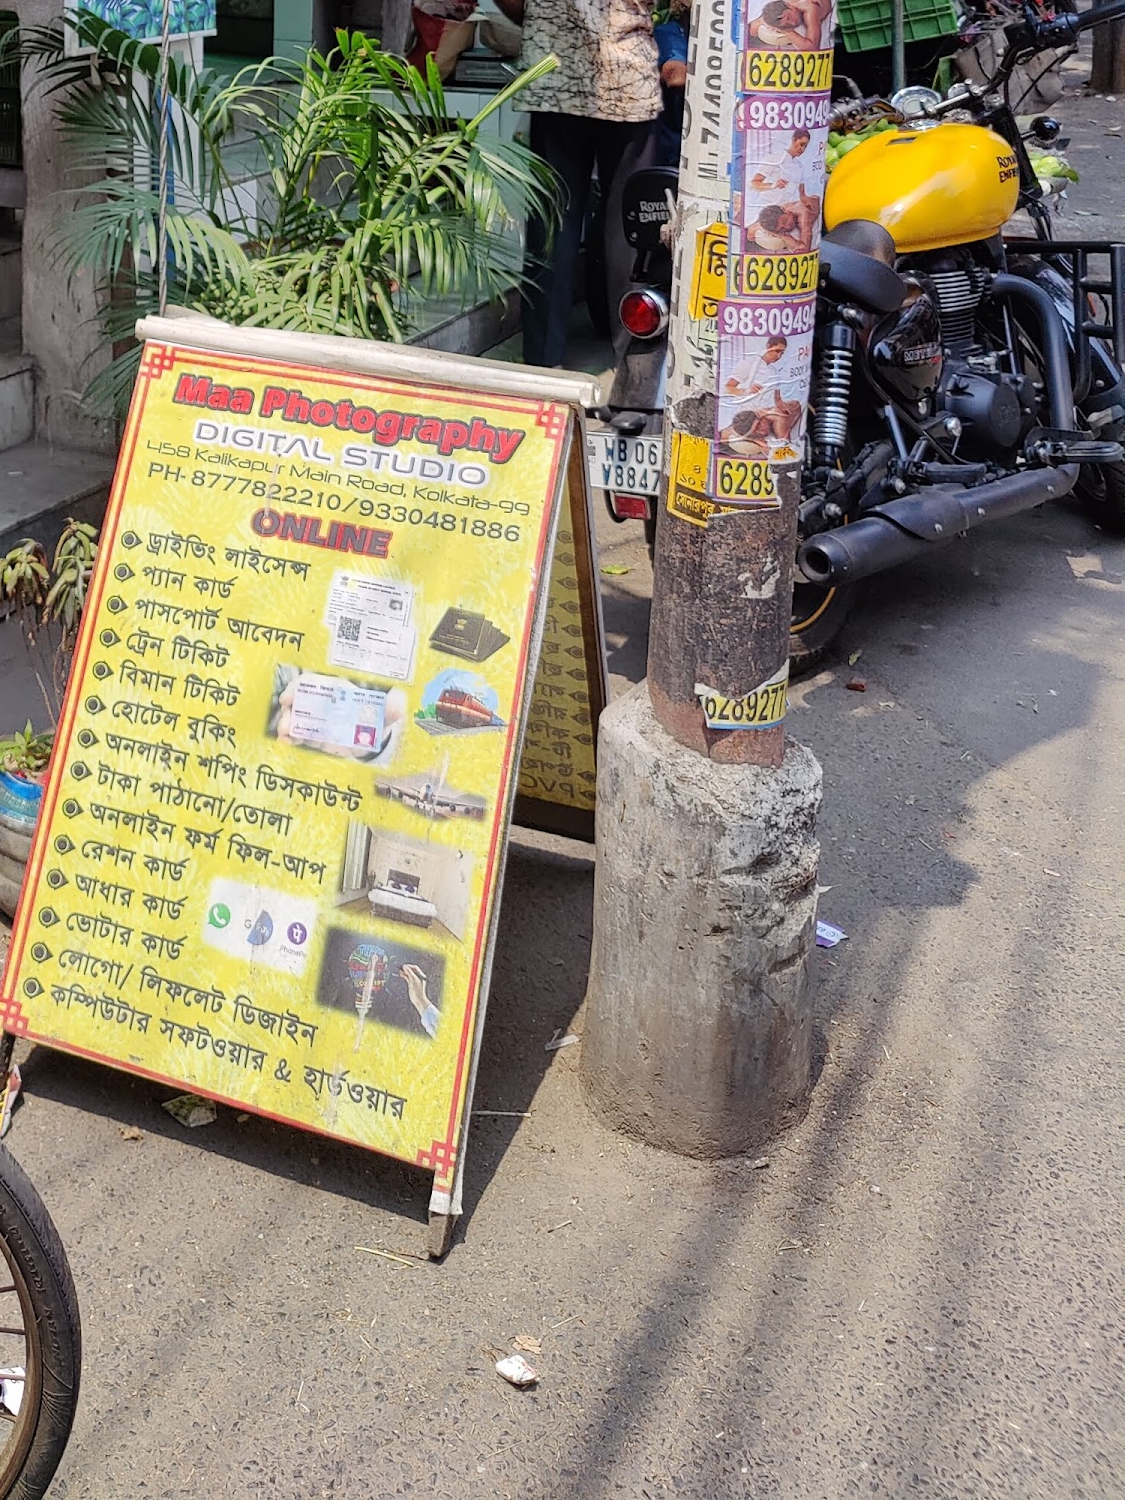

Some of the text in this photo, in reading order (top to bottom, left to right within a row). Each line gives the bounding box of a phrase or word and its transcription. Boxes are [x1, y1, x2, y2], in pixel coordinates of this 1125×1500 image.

[749, 53, 830, 88] 6289277
[175, 373, 526, 465] Maa Photography
[195, 421, 486, 487] DIGITAL STUDIO
[603, 439, 658, 463] WB 06
[146, 440, 530, 516] 458 Kalikapur Main Road, Kolkata-99
[191, 472, 521, 543] 8777822210/9330481886
[250, 507, 393, 559] ONLINE
[142, 565, 238, 600] প্যান কার্ড
[147, 532, 311, 582] ড্রাইভিং লাইসেন্স
[126, 628, 230, 669] ট্রেন টিকিট
[135, 598, 305, 652] পাসপোর্ট আবেদন
[119, 658, 241, 707] বিমান টিকিট
[112, 699, 236, 749] হোটেল বুকিং
[105, 731, 362, 813] অনলাইন শপিং ডিসকাউন্ট
[98, 762, 293, 837] টাকা পাঠানো/তোলা
[81, 838, 190, 882] রেশন কার্ড
[90, 801, 327, 886] অনলাইন ফর্ম ফিল-আপ
[75, 872, 189, 920] আধার কার্ড
[66, 911, 188, 960] ভোটার কার্ড
[58, 948, 318, 1048] লোগো/ লিফলেট ডিজাইন
[50, 982, 407, 1121] কম্পিউটার সফটওয়ার হার্ডওয়ার
